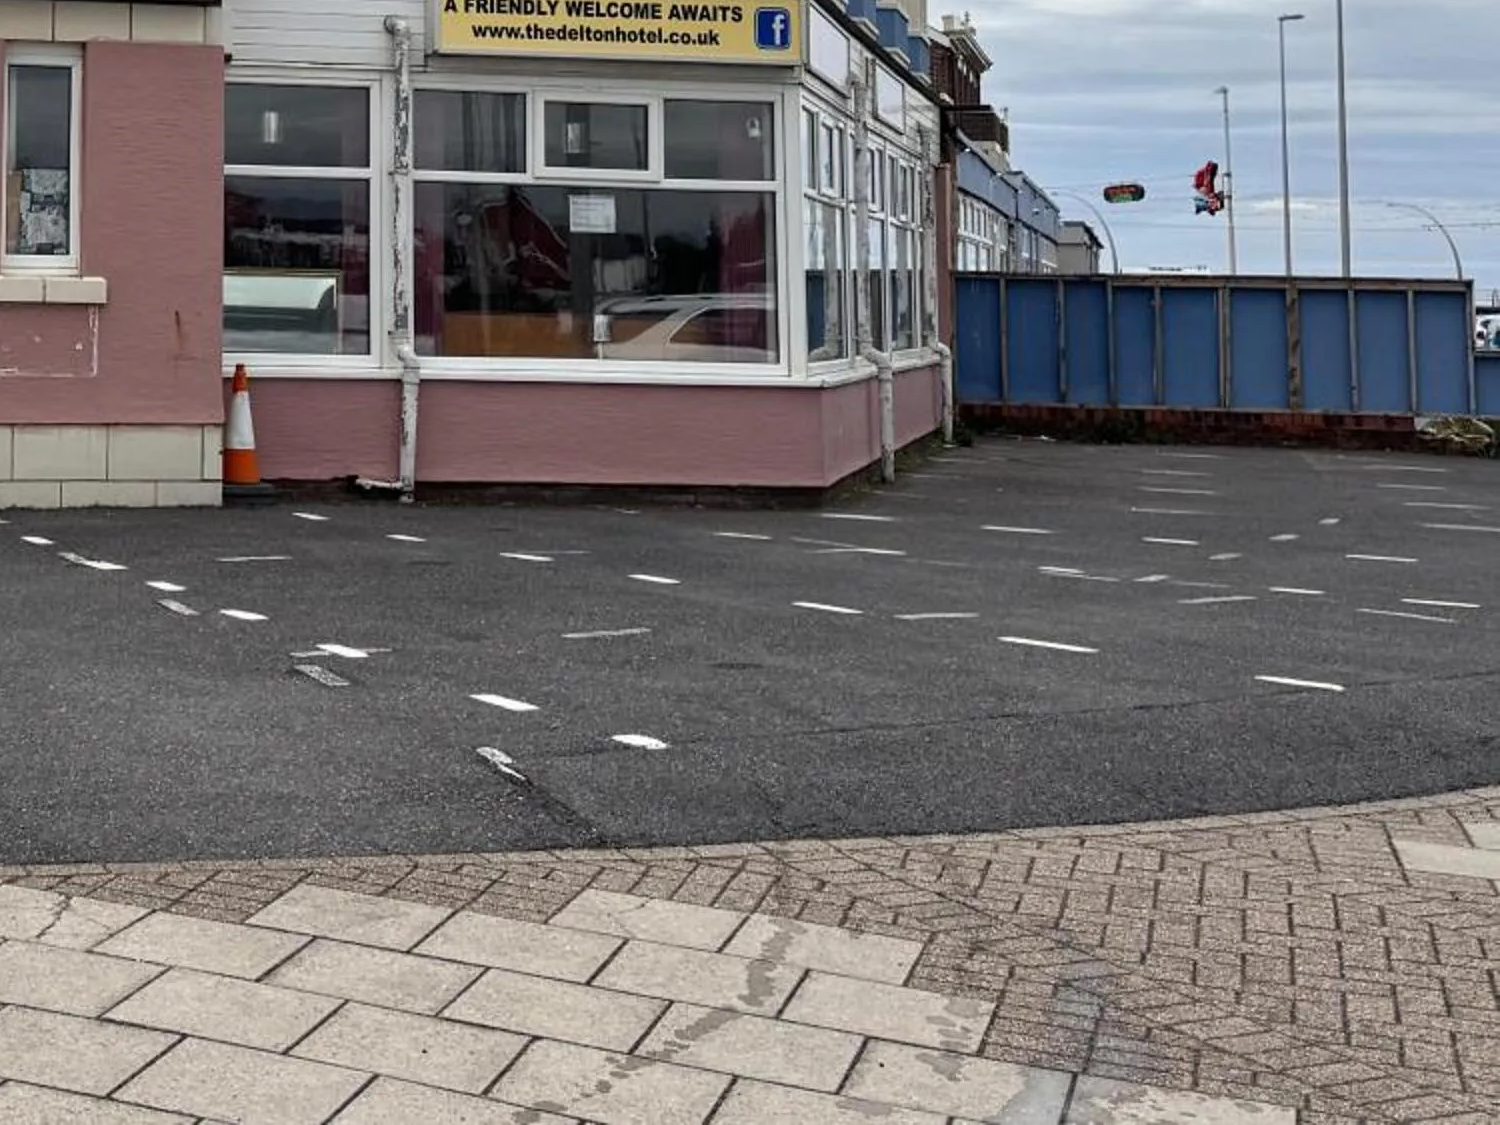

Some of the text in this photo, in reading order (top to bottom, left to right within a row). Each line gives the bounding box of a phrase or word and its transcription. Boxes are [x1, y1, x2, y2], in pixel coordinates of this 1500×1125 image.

[565, 0, 662, 21] WELCOME
[667, 4, 744, 23] AWAITS
[471, 22, 720, 46] www.thedeltonhotel.co.uk
